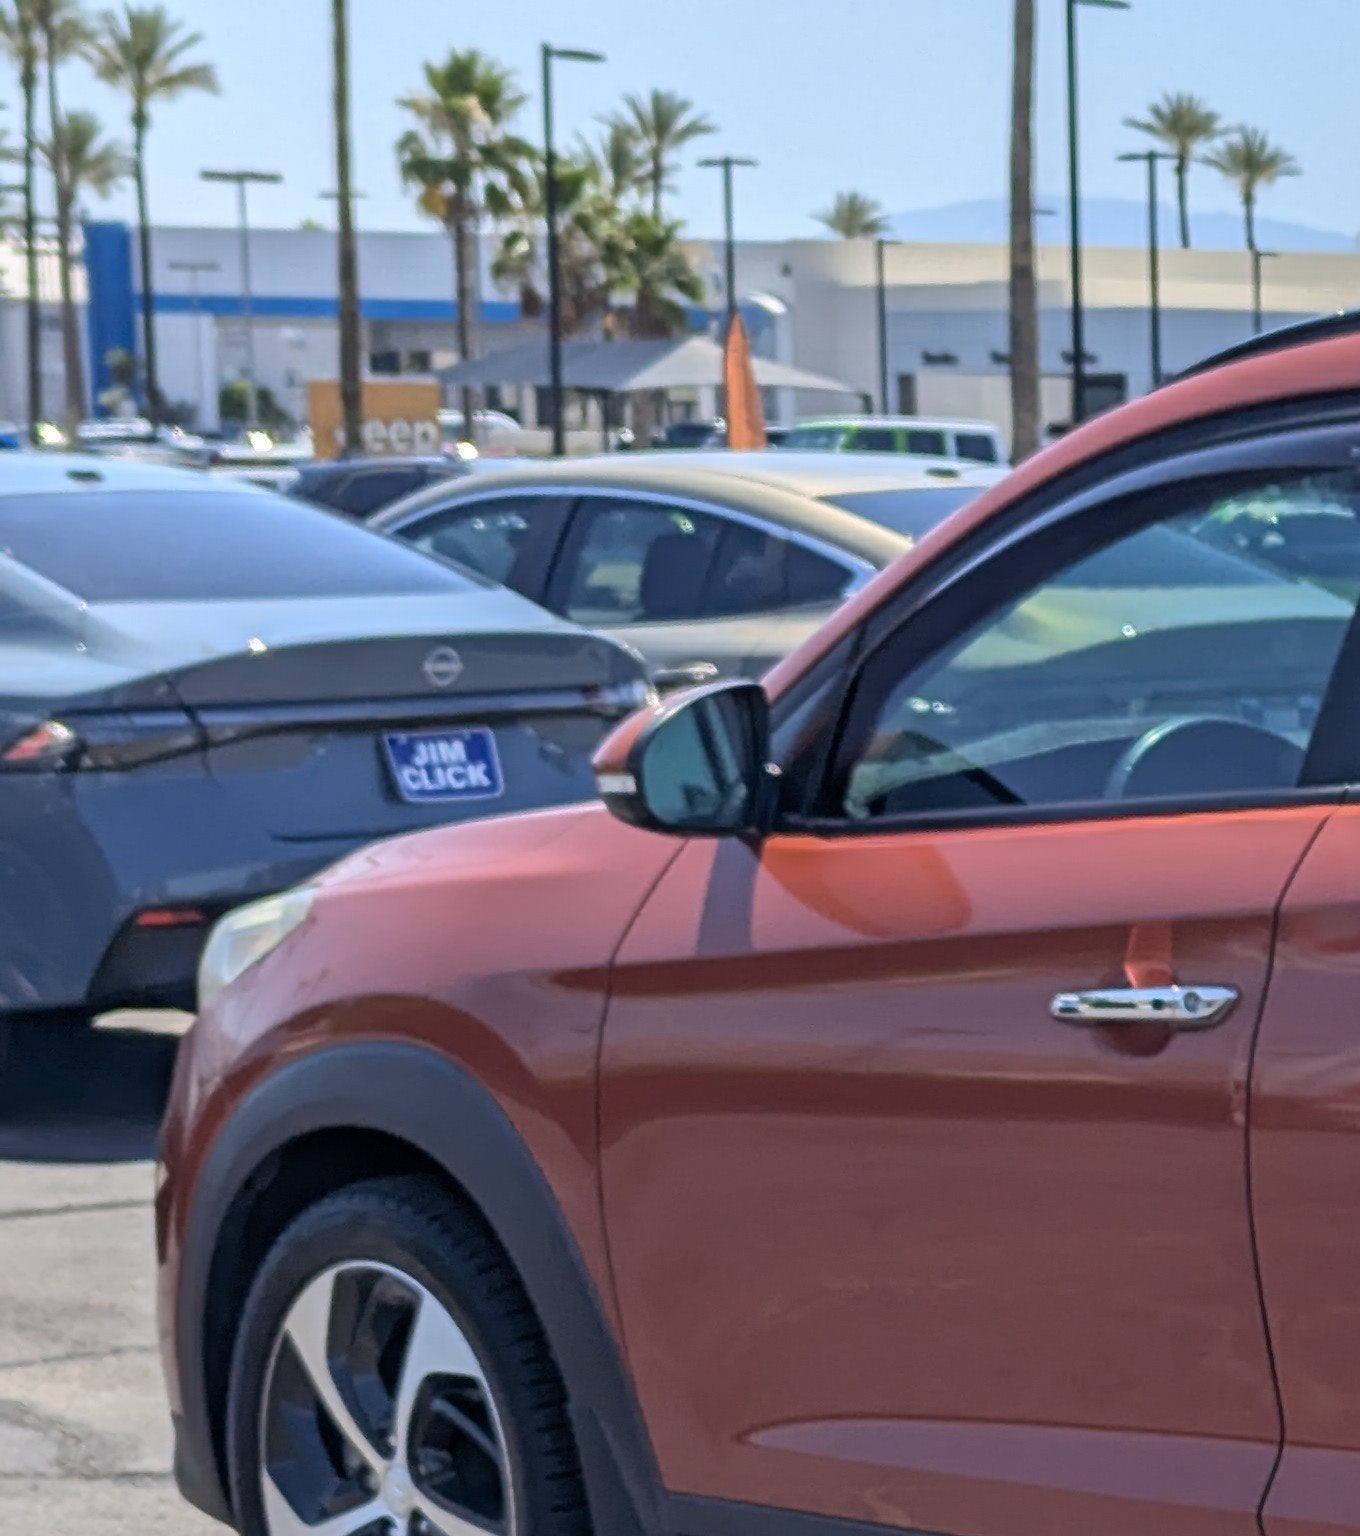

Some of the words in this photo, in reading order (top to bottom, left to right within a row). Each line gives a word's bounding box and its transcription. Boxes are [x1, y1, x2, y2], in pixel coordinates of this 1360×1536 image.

[333, 418, 438, 456] eep
[413, 740, 467, 766] JIM
[402, 762, 491, 791] CLICK
